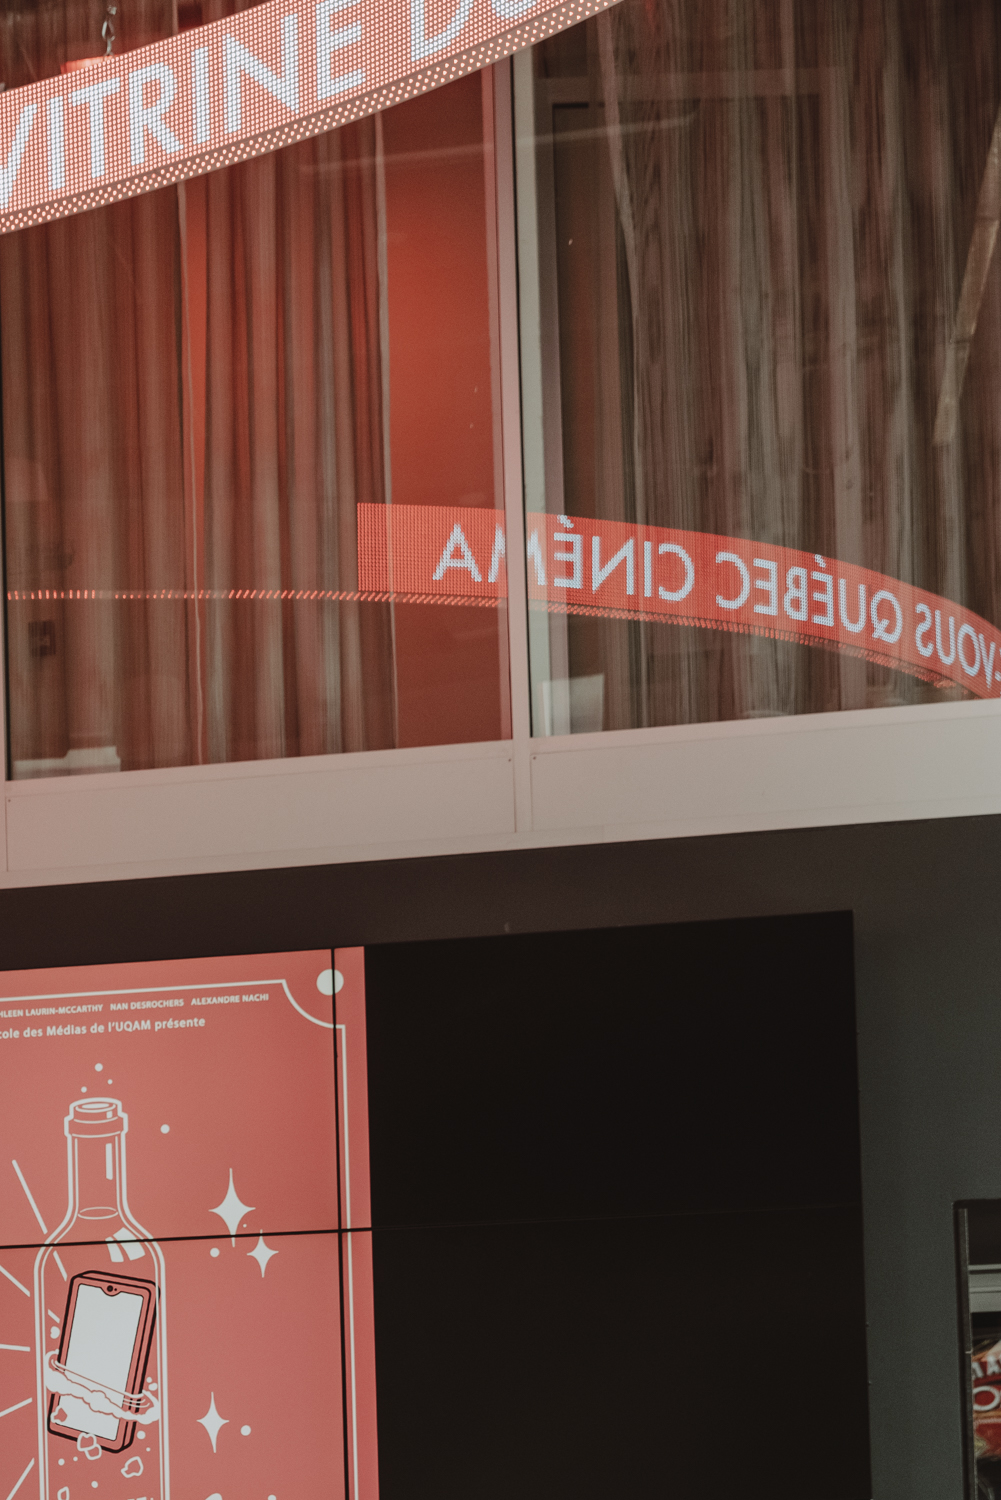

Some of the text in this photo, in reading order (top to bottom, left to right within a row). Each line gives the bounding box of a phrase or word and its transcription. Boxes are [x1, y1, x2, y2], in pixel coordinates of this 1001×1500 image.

[411, 0, 537, 61] D
[26, 1004, 103, 1016] LAURIN-MCCARTHY
[110, 1002, 128, 1011] NAN
[130, 999, 184, 1010] DESROCHERS
[191, 995, 240, 1006] ALEXANDRE
[242, 994, 269, 1002] NACHI
[23, 1026, 43, 1038] des
[47, 1023, 86, 1036] Médias
[90, 1022, 104, 1033] de
[108, 1020, 150, 1032] l'UQAM
[155, 1017, 205, 1031] présente
